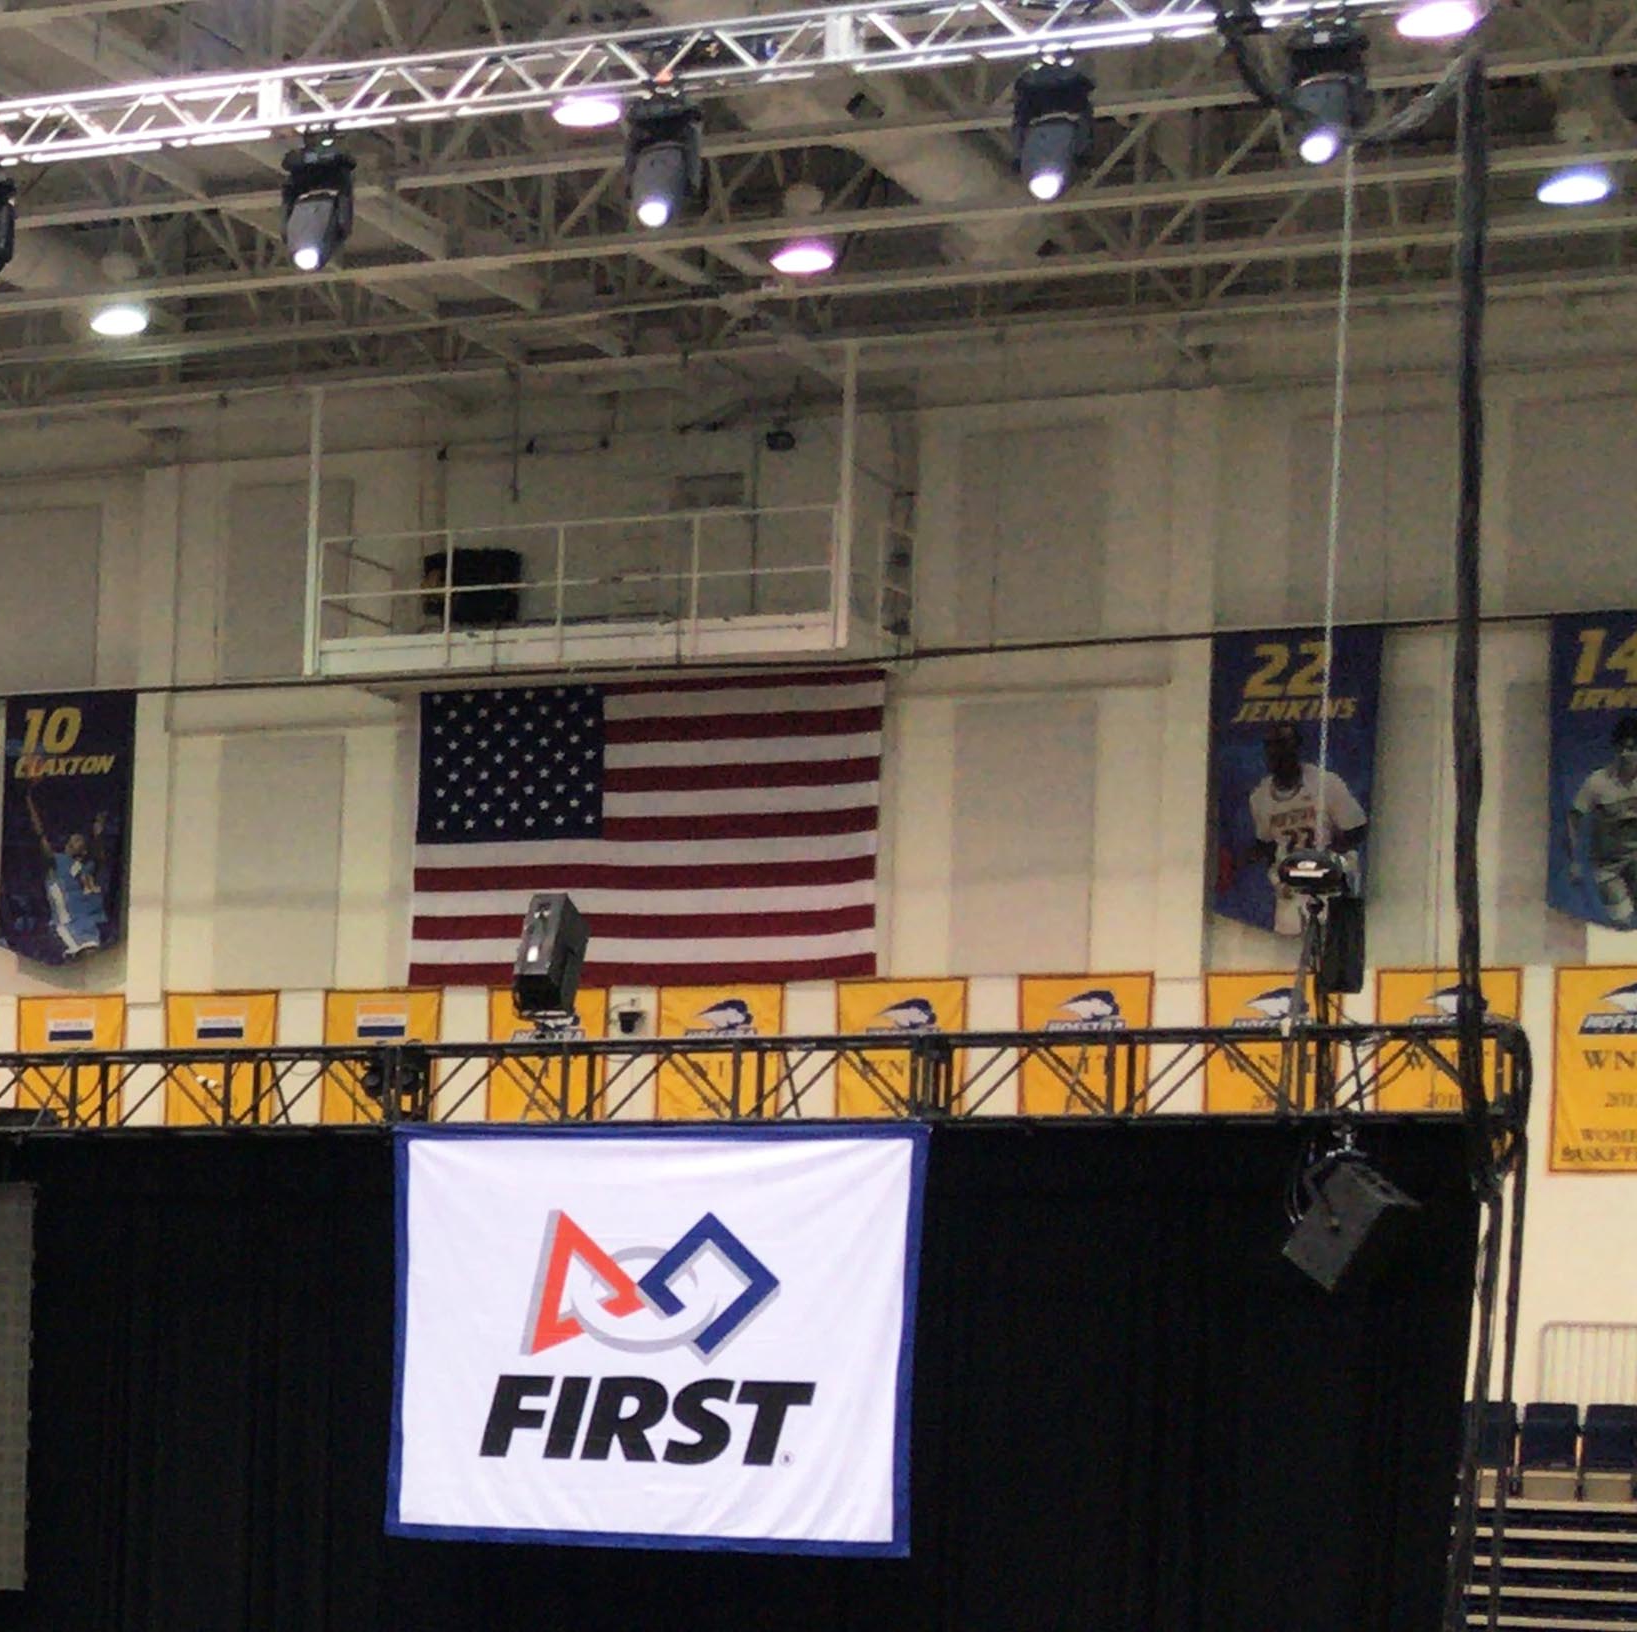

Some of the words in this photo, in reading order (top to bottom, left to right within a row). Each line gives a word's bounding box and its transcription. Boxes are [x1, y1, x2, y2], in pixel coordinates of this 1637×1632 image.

[1244, 640, 1329, 700] 22
[24, 707, 82, 754] 10
[1231, 696, 1357, 723] JENKINS
[14, 754, 116, 779] CLAXTON
[479, 1374, 818, 1466] FIRST
